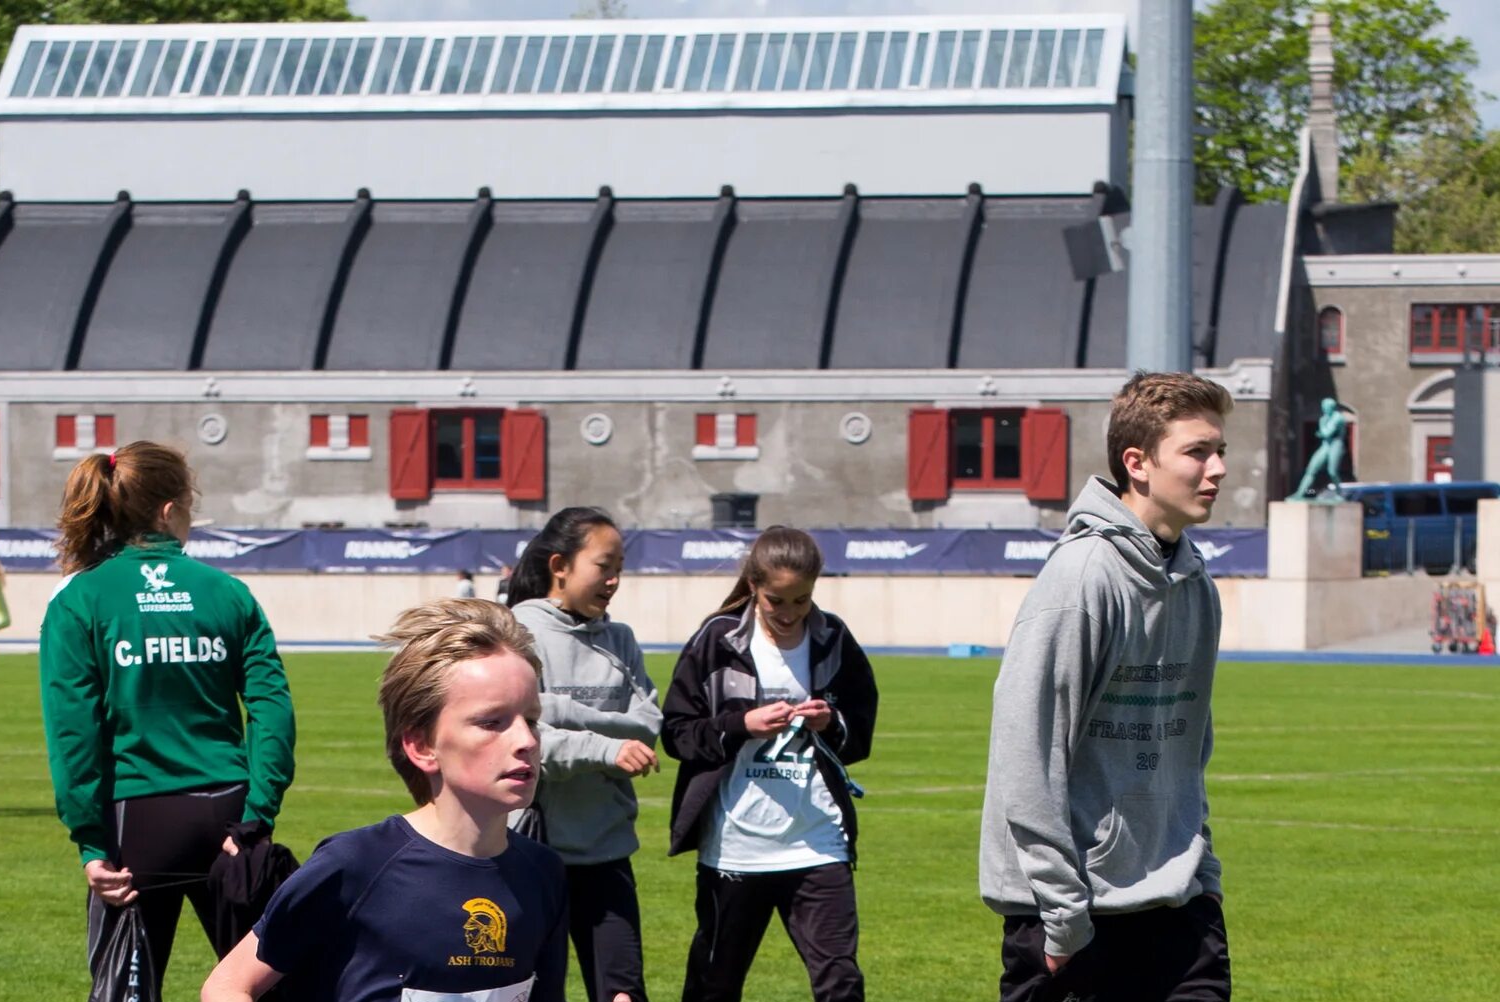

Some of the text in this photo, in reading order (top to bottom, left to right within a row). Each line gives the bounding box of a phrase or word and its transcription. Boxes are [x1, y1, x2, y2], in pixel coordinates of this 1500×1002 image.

[344, 541, 410, 559] RUNNING
[845, 541, 907, 559] RUNNING
[136, 591, 192, 604] EAGLES
[139, 603, 194, 613] LUXEMBOURG
[114, 636, 228, 667] C. FIELDS
[448, 955, 472, 966] ASH
